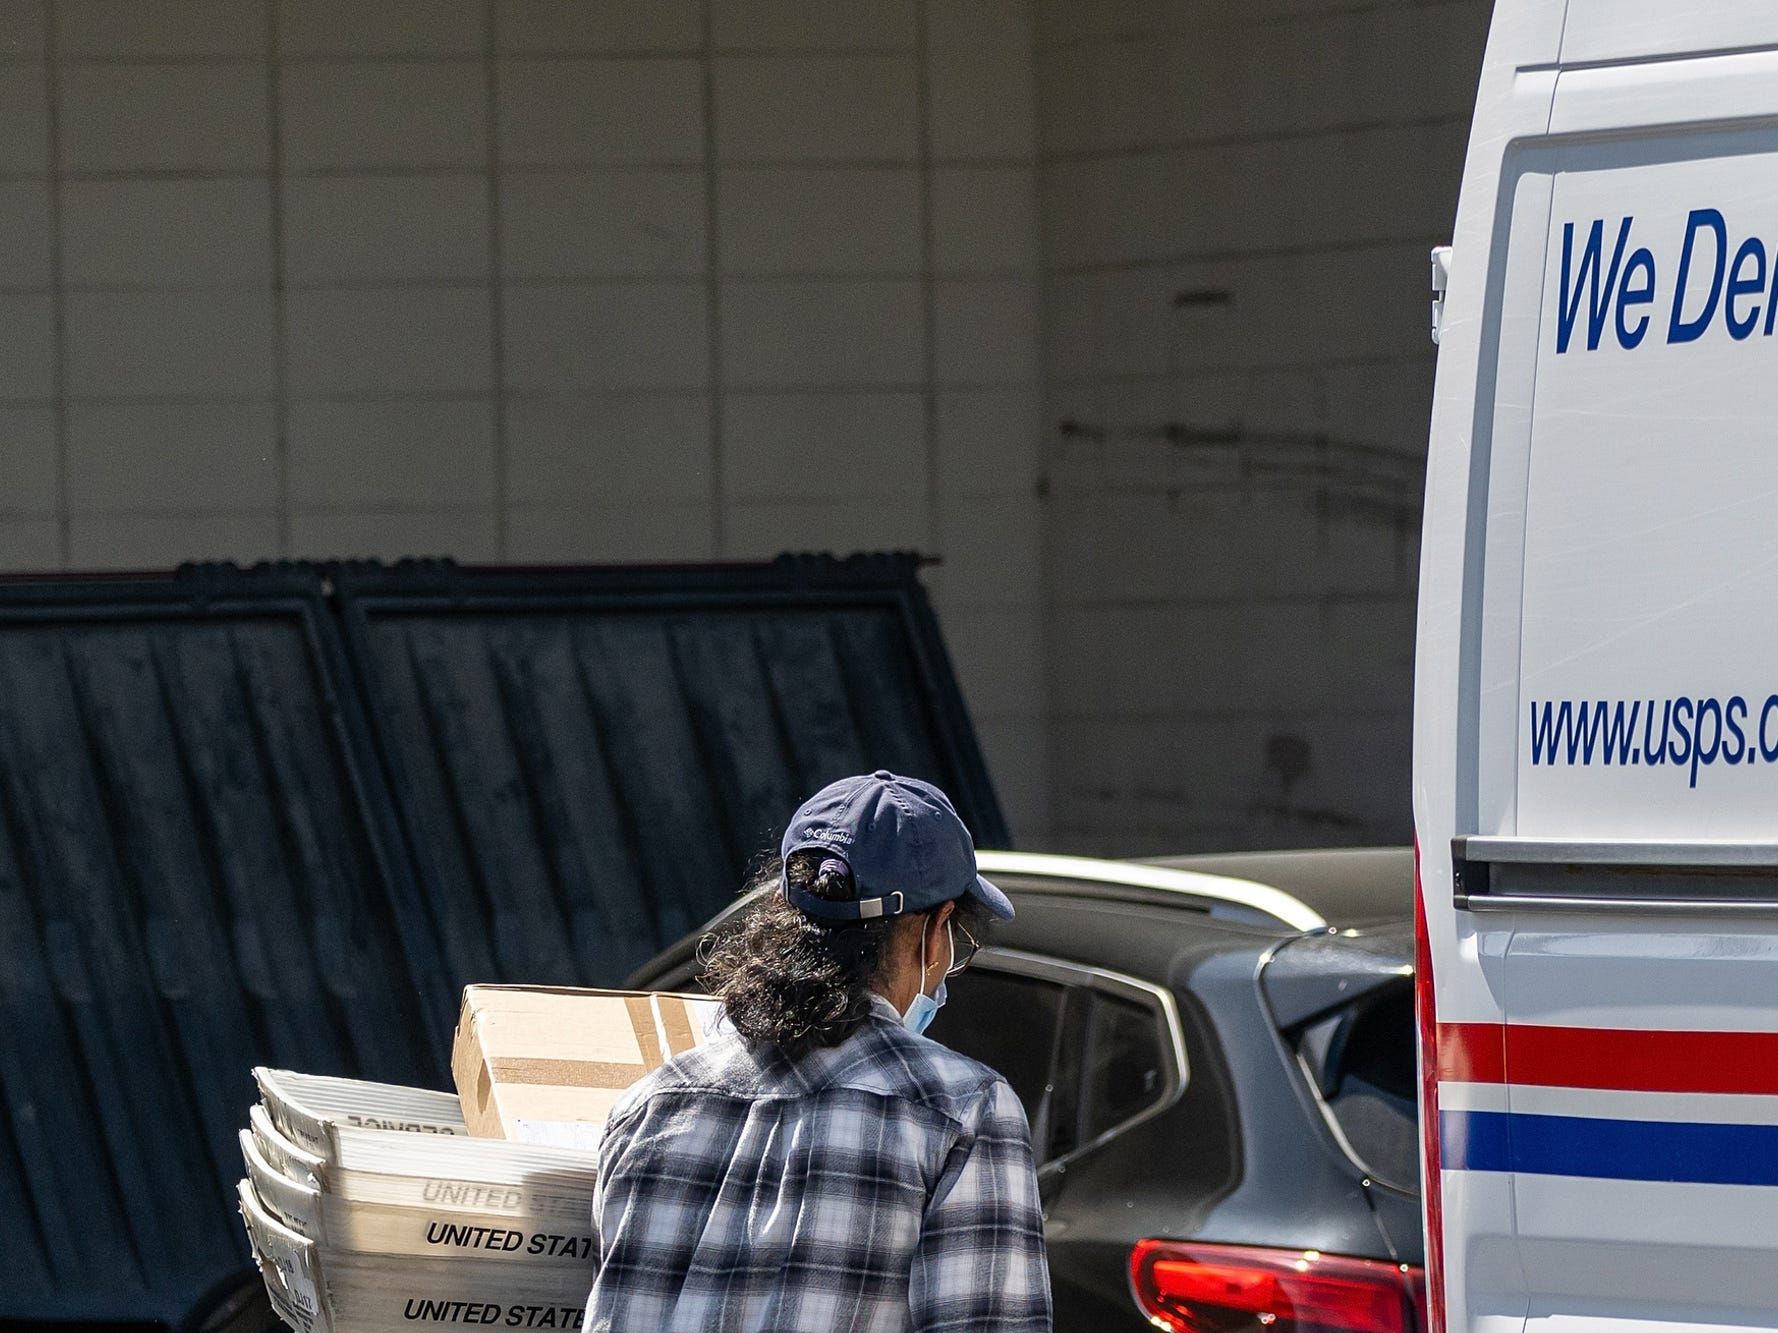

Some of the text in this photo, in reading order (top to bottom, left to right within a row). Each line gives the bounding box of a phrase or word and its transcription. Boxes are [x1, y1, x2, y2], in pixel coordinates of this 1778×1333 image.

[1556, 216, 1656, 355] We
[813, 828, 853, 845] Columbia
[423, 1180, 522, 1210] UNITED
[426, 1222, 524, 1252] UNITED
[404, 1299, 502, 1325] UNITED
